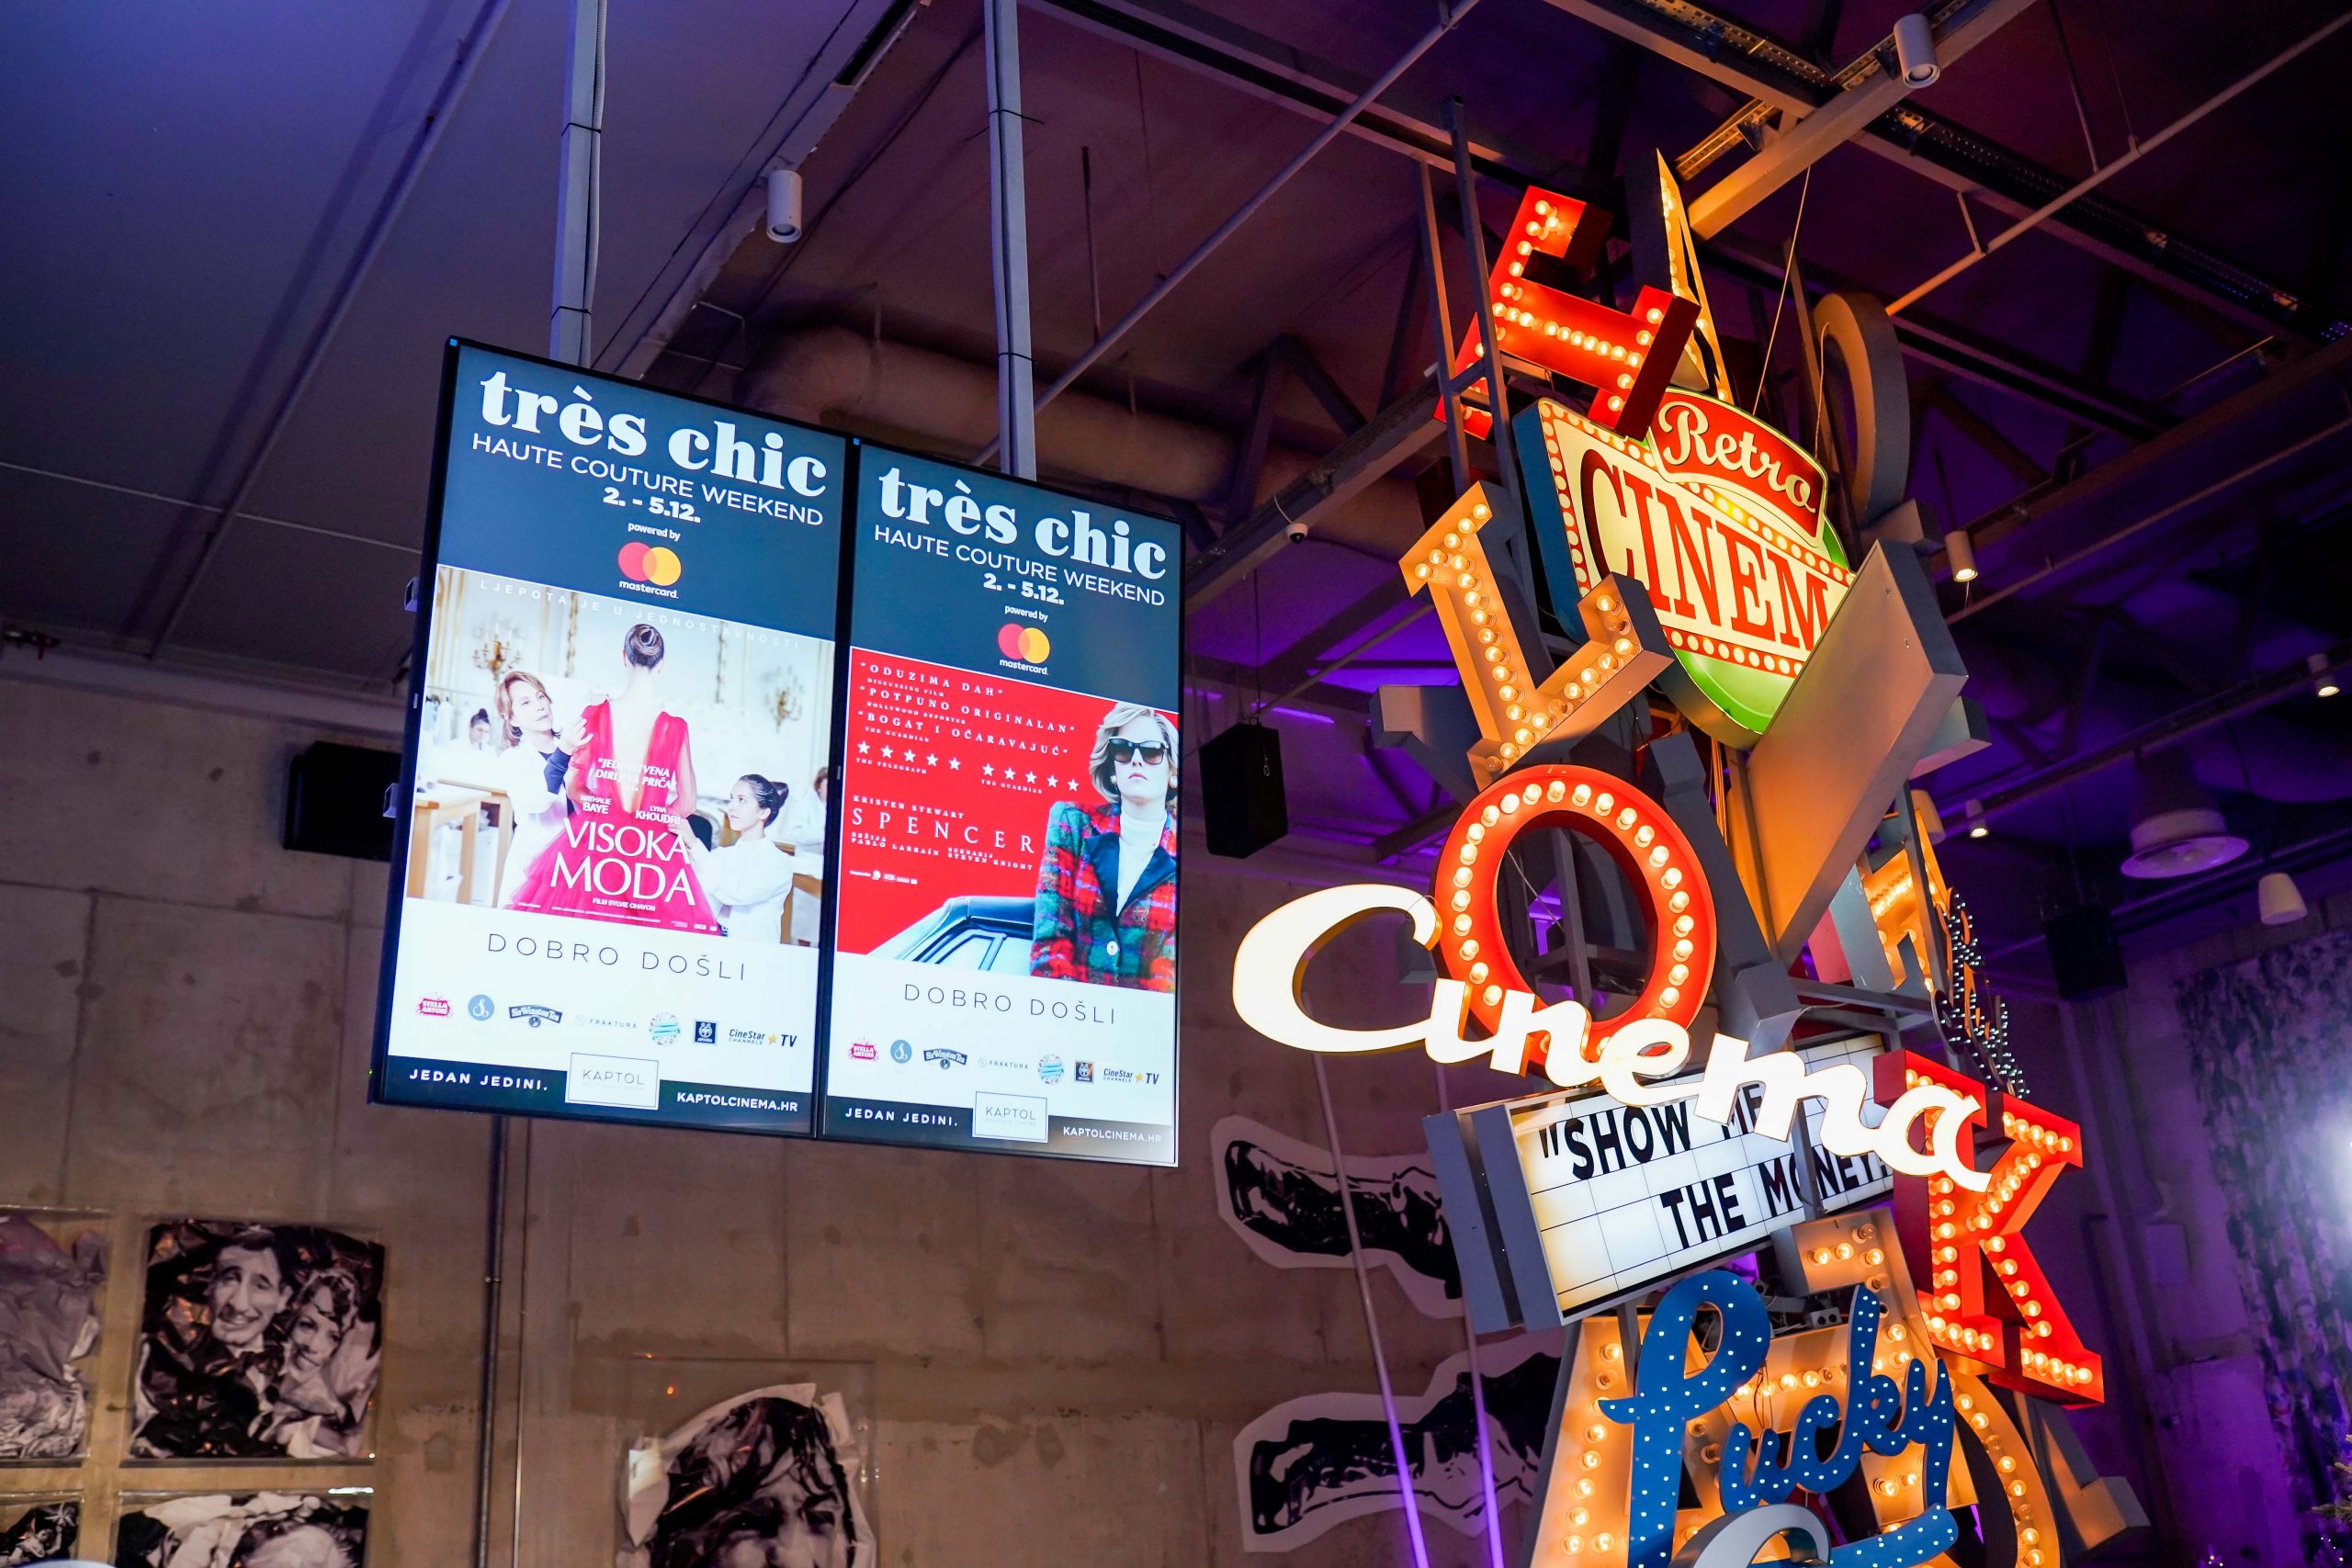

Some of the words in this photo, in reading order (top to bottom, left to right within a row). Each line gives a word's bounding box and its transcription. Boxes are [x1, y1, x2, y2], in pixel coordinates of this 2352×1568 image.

[481, 371, 647, 457] très
[668, 421, 827, 497] chic
[1658, 401, 1815, 513] Retro
[472, 433, 563, 468] HAUTE
[571, 457, 694, 498] COUTURE
[701, 483, 823, 526] WEEKEND
[603, 487, 627, 507] 2.
[649, 497, 701, 524] 5.12.
[628, 523, 667, 539] powered
[669, 530, 681, 542] by
[878, 468, 1018, 544] très
[1035, 510, 1167, 580] chic
[875, 525, 949, 558] HAUTE
[956, 545, 1057, 582] COUTURE
[1064, 569, 1165, 606] WEEKEND
[983, 572, 1002, 592] 2.
[1021, 581, 1065, 605] 5.12.
[481, 580, 567, 604] LJEPOTA
[581, 599, 601, 611] JE
[614, 606, 622, 615] U
[636, 611, 799, 649] JEDNOSTAVNOSTI
[1004, 605, 1038, 620] powered
[1038, 612, 1049, 624] by
[861, 662, 950, 687] "ODUZIMA
[962, 682, 1002, 695] DAH"
[858, 711, 923, 730] "BOGAT
[860, 685, 949, 710] "POTPUNO
[961, 705, 1074, 733] ORIGINALAN"
[866, 702, 919, 716] HOLLYWOOD
[923, 712, 966, 725] REPORTER
[886, 730, 930, 742] GUARDIAN
[1001, 783, 1042, 794] GUARDIAN
[582, 802, 609, 815] BAYE
[853, 795, 905, 809] KRISTEN
[911, 805, 964, 819] STEWART
[563, 818, 691, 864] VISOKA
[852, 808, 1035, 853] SPENCER
[851, 838, 886, 848] PABLO
[947, 852, 988, 863] STEVEN
[993, 860, 1033, 871] KNIGHT
[550, 852, 695, 906] MODA
[489, 933, 618, 964] DOBRO
[642, 952, 744, 981] DOŠLI
[905, 984, 1011, 1011] DOBRO
[1030, 998, 1114, 1024] DOŠLI
[589, 1018, 637, 1028] FRAKTURA
[729, 1029, 766, 1040] CineStar
[781, 1034, 797, 1047] TV
[1233, 885, 1992, 1191] Cinema
[989, 1060, 1029, 1070] FRAKTURA
[1103, 1068, 1133, 1077] CineStar
[1147, 1073, 1159, 1084] TV
[409, 1068, 470, 1084] JEDAN
[481, 1075, 548, 1091] JEDINI.
[582, 1069, 644, 1085] KAPTOL
[677, 1092, 798, 1112] KAPTOLCINEMA.HR
[986, 1106, 1036, 1121] KAPTOL
[845, 1108, 895, 1121] JEDAN
[903, 1112, 958, 1126] JEDINI.
[1063, 1126, 1162, 1143] KAPTOLCINEMA.HR
[1539, 1100, 1691, 1180] "SHOW
[1660, 1172, 1747, 1249] THE
